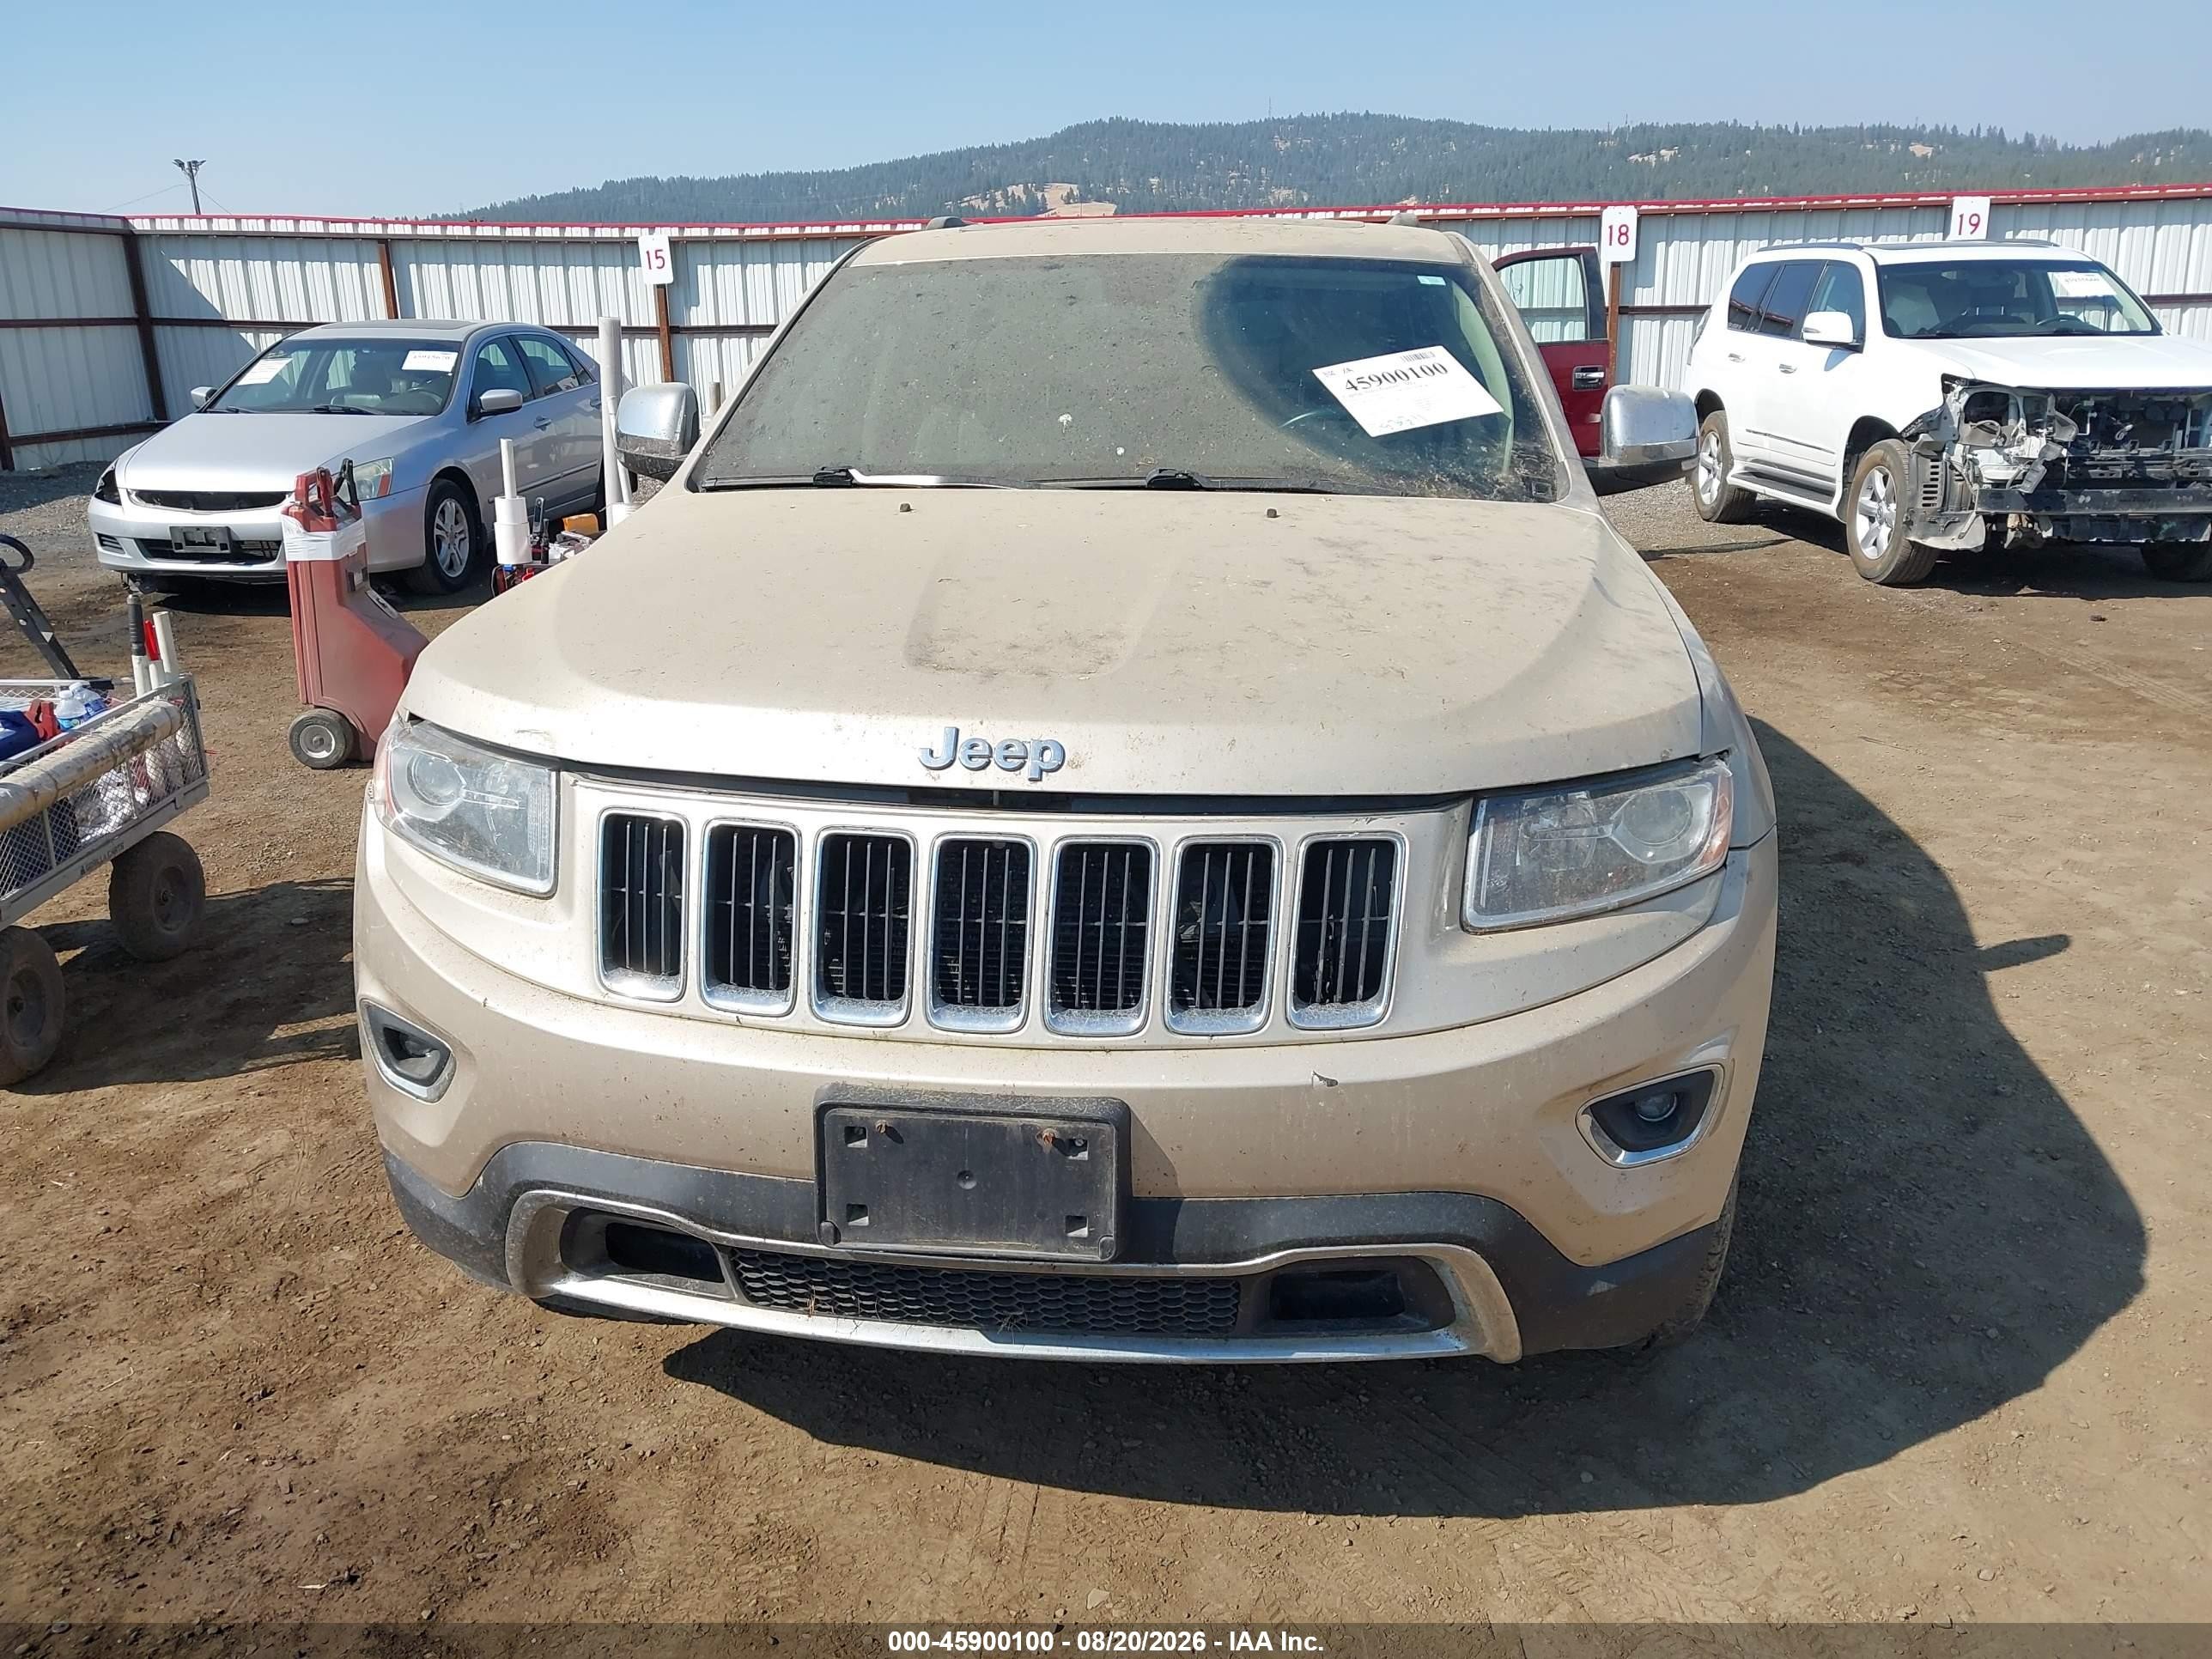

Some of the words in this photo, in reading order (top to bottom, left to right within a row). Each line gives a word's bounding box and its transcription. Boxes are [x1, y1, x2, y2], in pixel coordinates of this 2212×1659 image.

[1607, 223, 1630, 246] 18
[1959, 212, 1981, 236] 19
[645, 248, 665, 270] 15
[1345, 362, 1449, 392] 45900100
[918, 726, 1066, 781] Jeep
